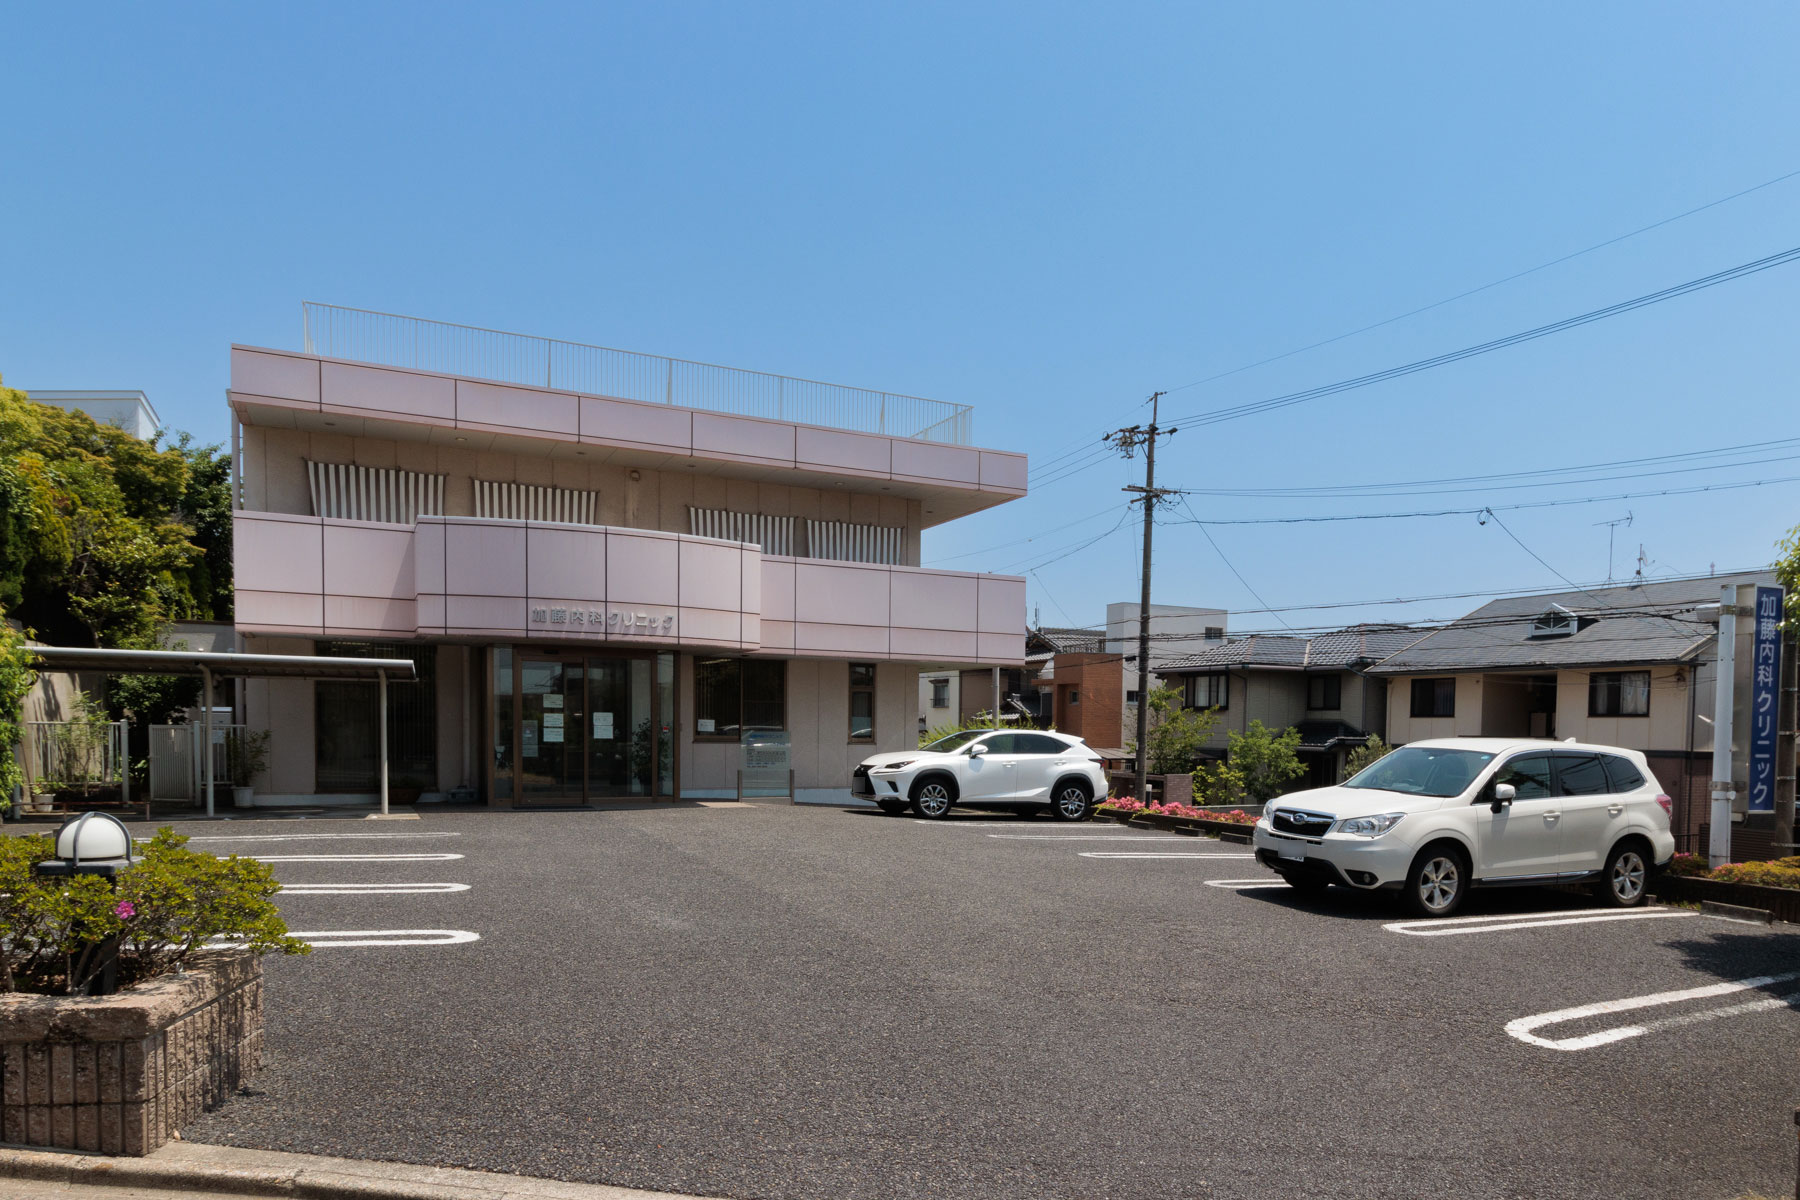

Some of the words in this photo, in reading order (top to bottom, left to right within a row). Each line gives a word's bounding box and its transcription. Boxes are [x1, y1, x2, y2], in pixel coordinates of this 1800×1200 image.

[532, 607, 675, 628] 加藤内科クリニック
[1753, 594, 1777, 804] 加藤内科クリニック
